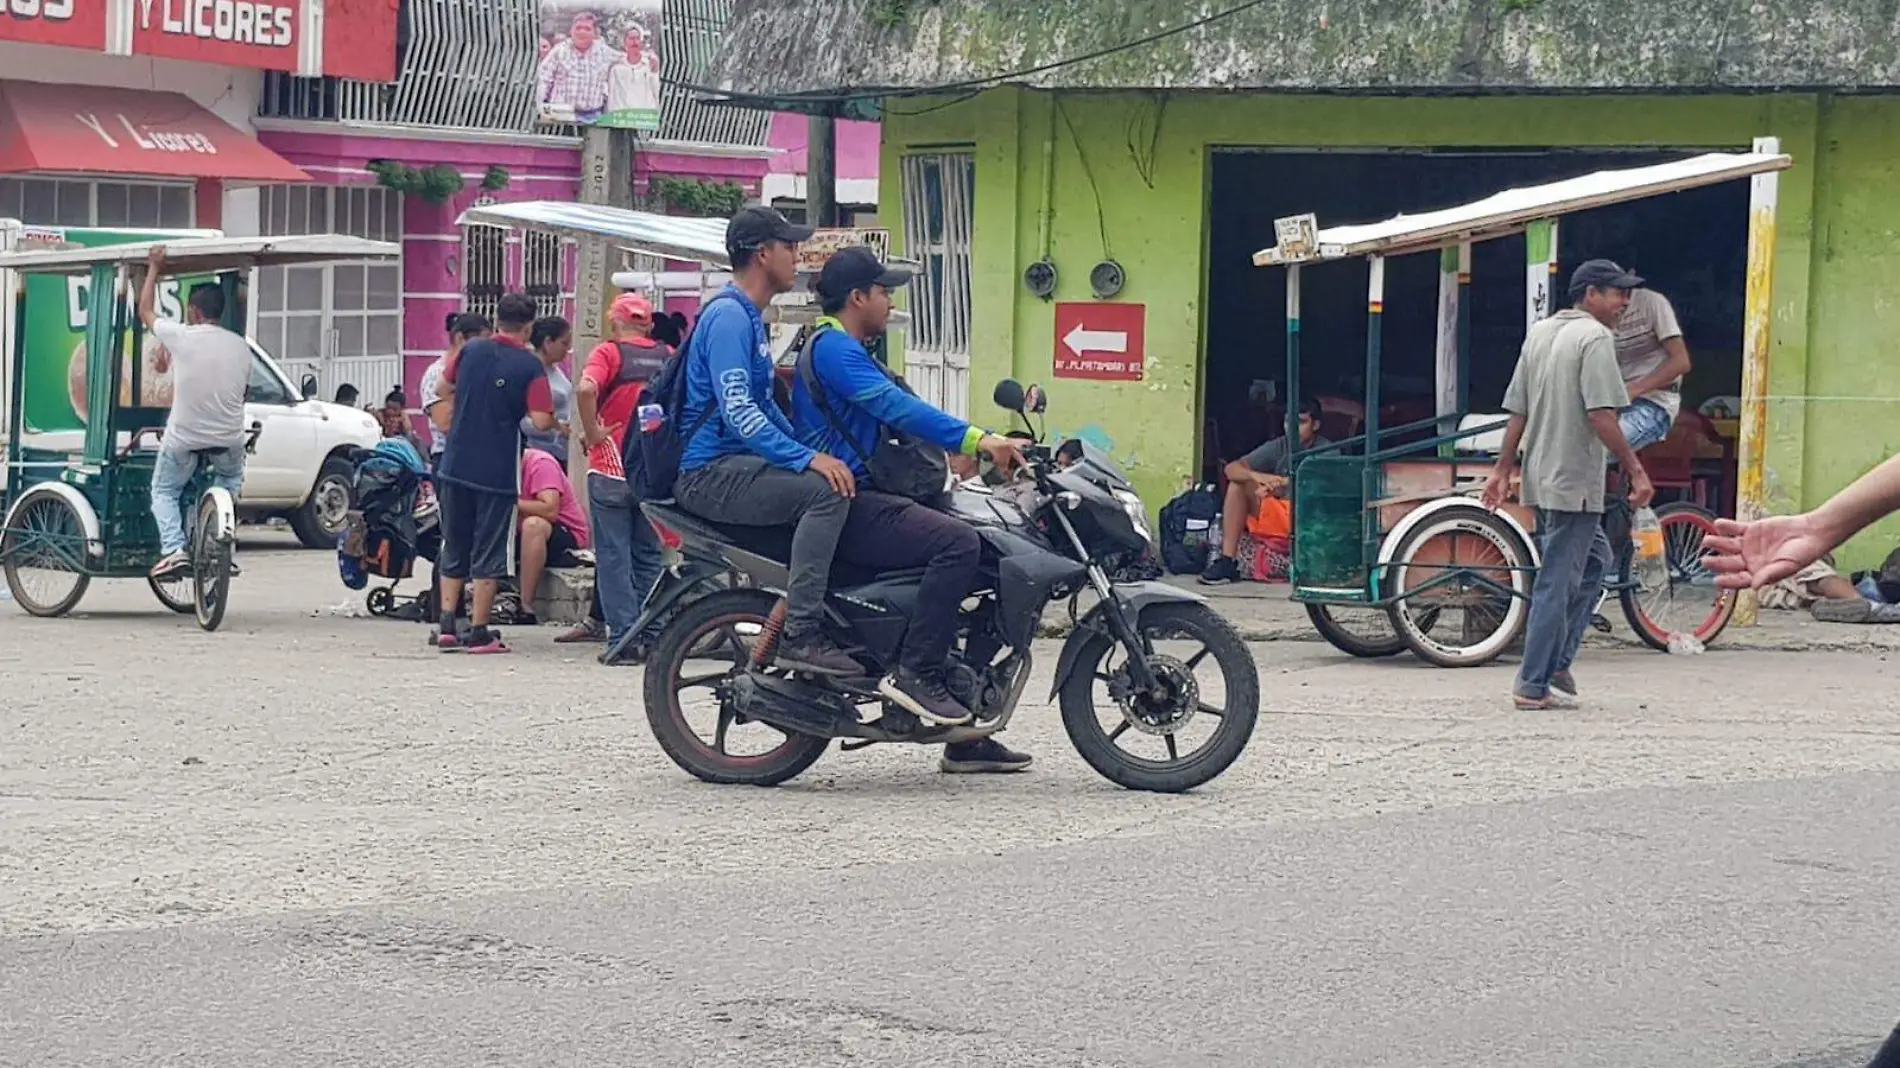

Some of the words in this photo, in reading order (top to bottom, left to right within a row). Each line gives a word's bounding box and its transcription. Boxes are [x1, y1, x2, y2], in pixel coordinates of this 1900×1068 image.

[162, 0, 293, 46] LICORES
[76, 113, 119, 148] Y
[116, 113, 217, 154] Licores
